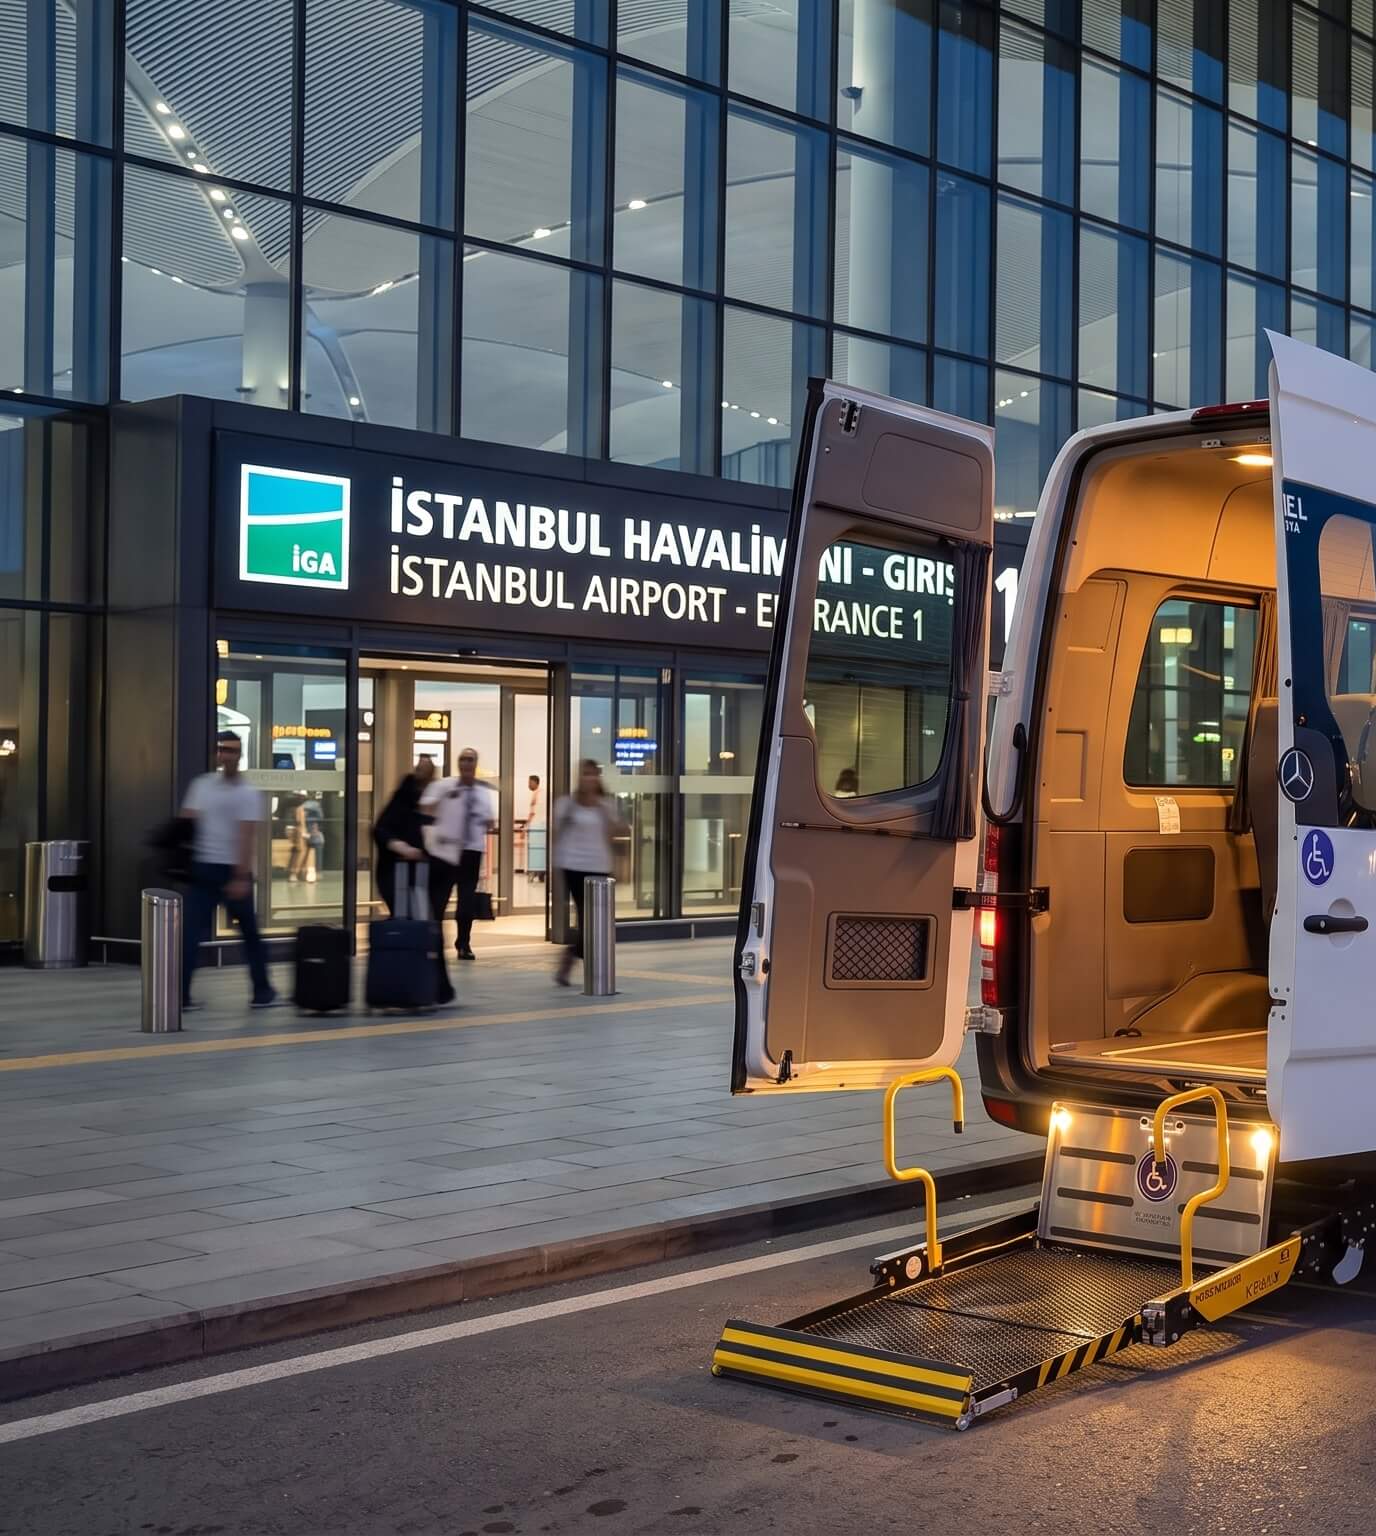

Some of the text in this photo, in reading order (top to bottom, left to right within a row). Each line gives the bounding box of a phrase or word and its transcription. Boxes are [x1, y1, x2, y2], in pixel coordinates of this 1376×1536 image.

[390, 476, 611, 557] İSTANBUL
[624, 517, 852, 585] HAVALİMNI
[389, 544, 575, 611] İSTANBUL
[582, 574, 727, 623] AIRPORT
[756, 592, 904, 640] ERANCE
[912, 608, 923, 641] 1
